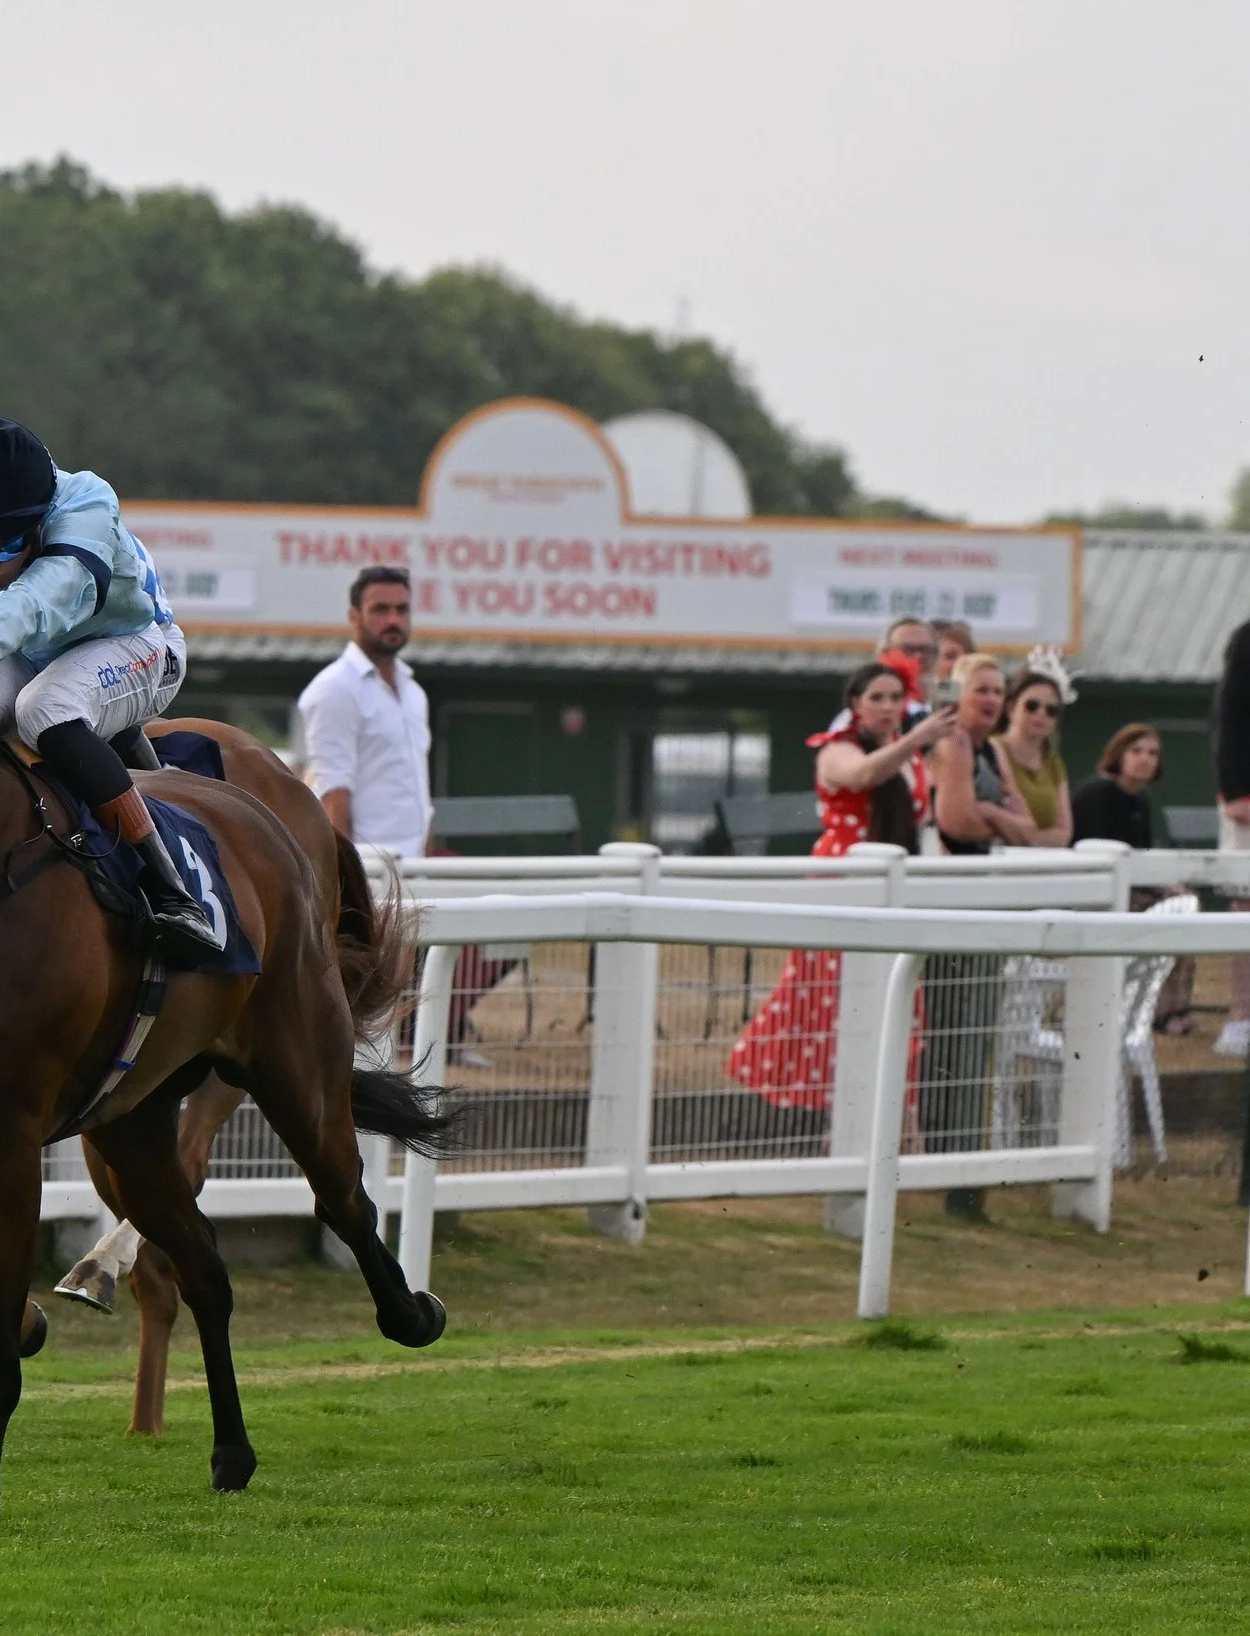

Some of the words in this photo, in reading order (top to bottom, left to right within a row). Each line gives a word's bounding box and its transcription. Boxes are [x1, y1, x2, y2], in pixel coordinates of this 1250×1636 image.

[276, 530, 411, 567] THANK
[422, 535, 508, 571] YOU
[513, 537, 594, 574] FOR
[602, 540, 773, 579] VISITING
[453, 579, 537, 617] YOU
[543, 582, 658, 619] SOON
[178, 834, 228, 951] 3
